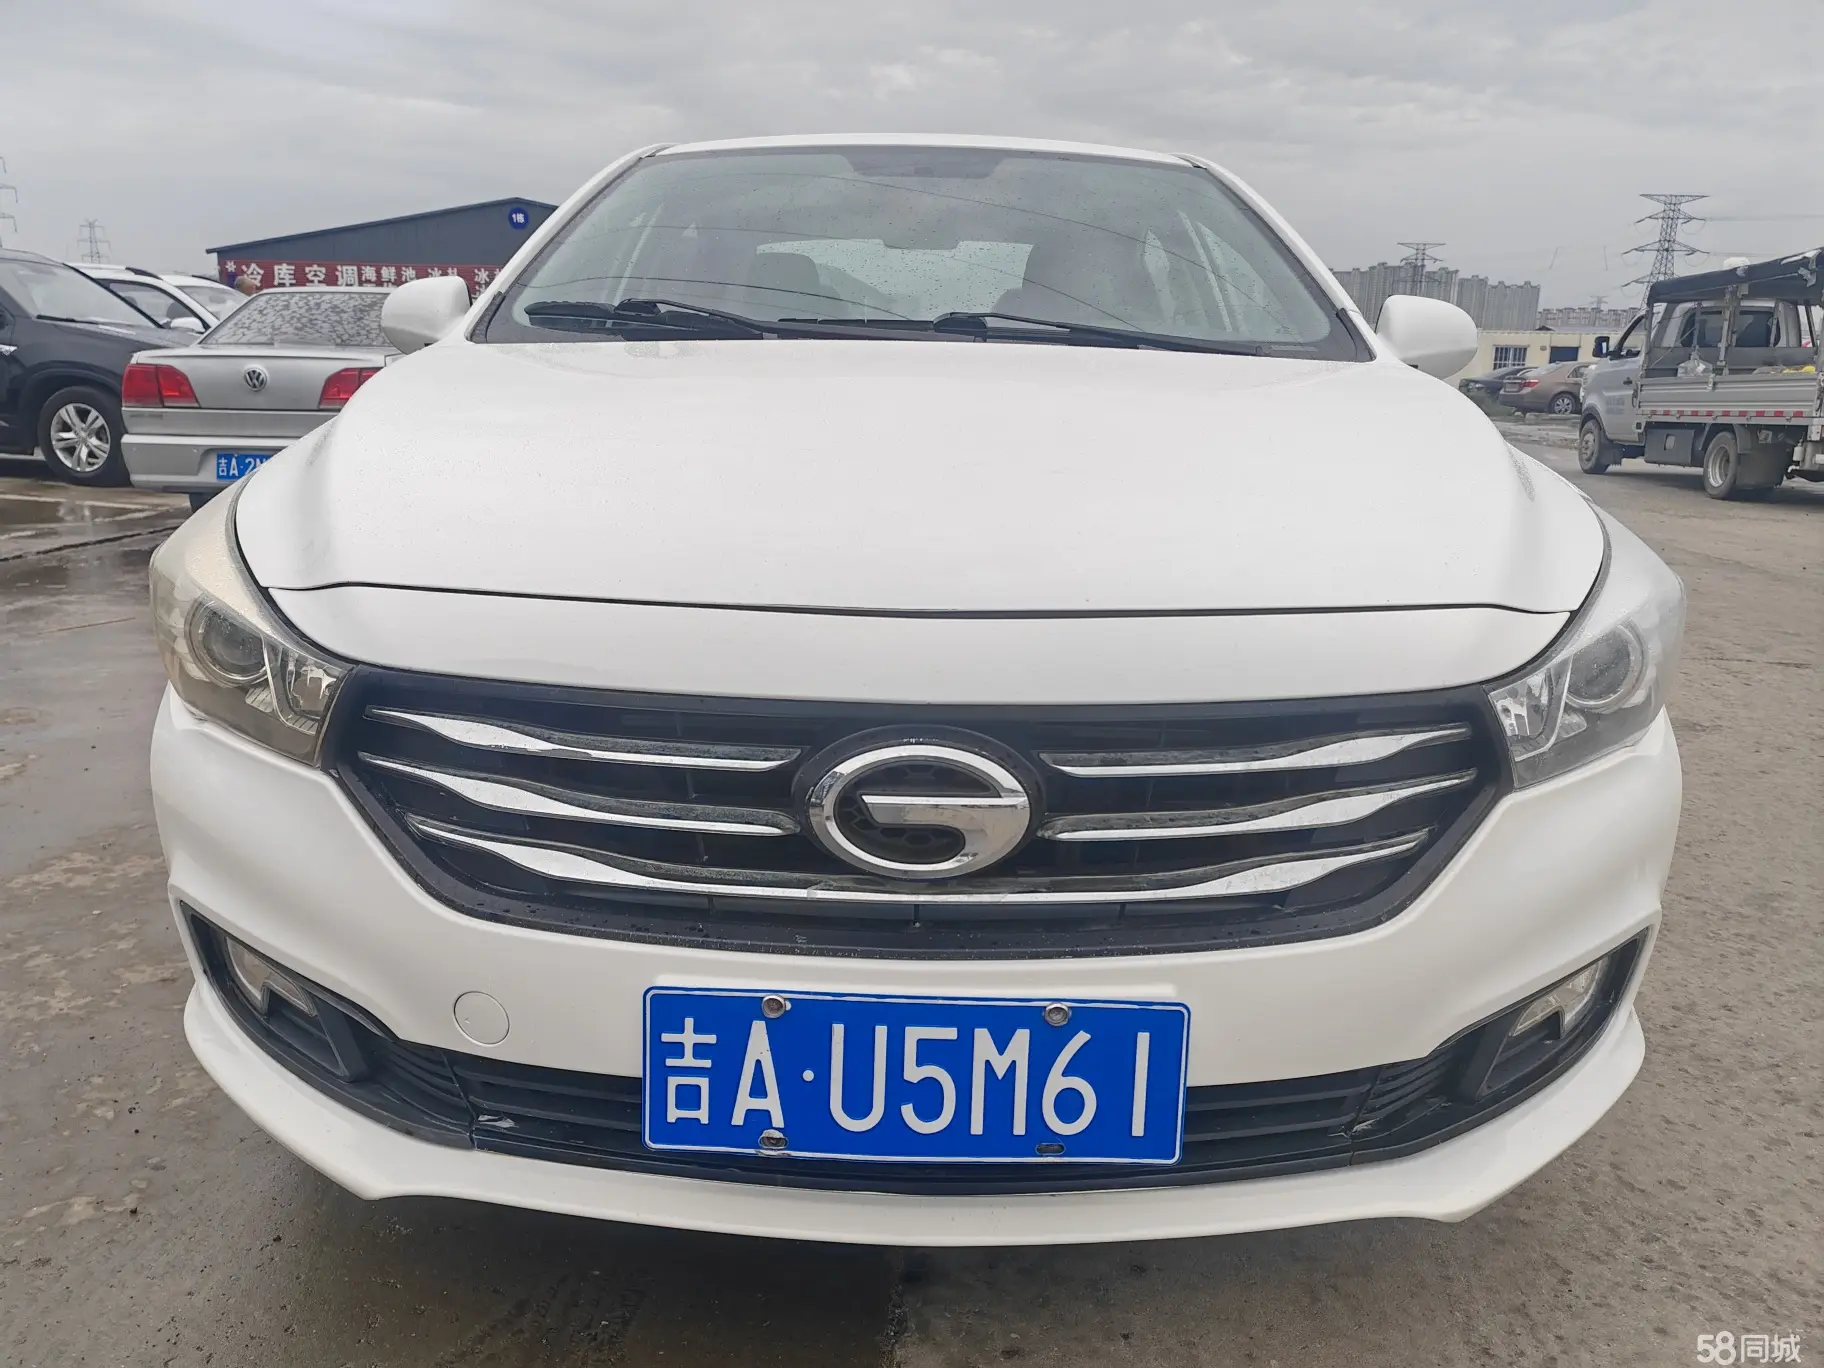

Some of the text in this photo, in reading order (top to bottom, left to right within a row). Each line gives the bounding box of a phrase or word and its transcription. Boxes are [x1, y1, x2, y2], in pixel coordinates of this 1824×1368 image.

[241, 262, 358, 287] 冷库空调
[361, 265, 417, 283] 海鲜池
